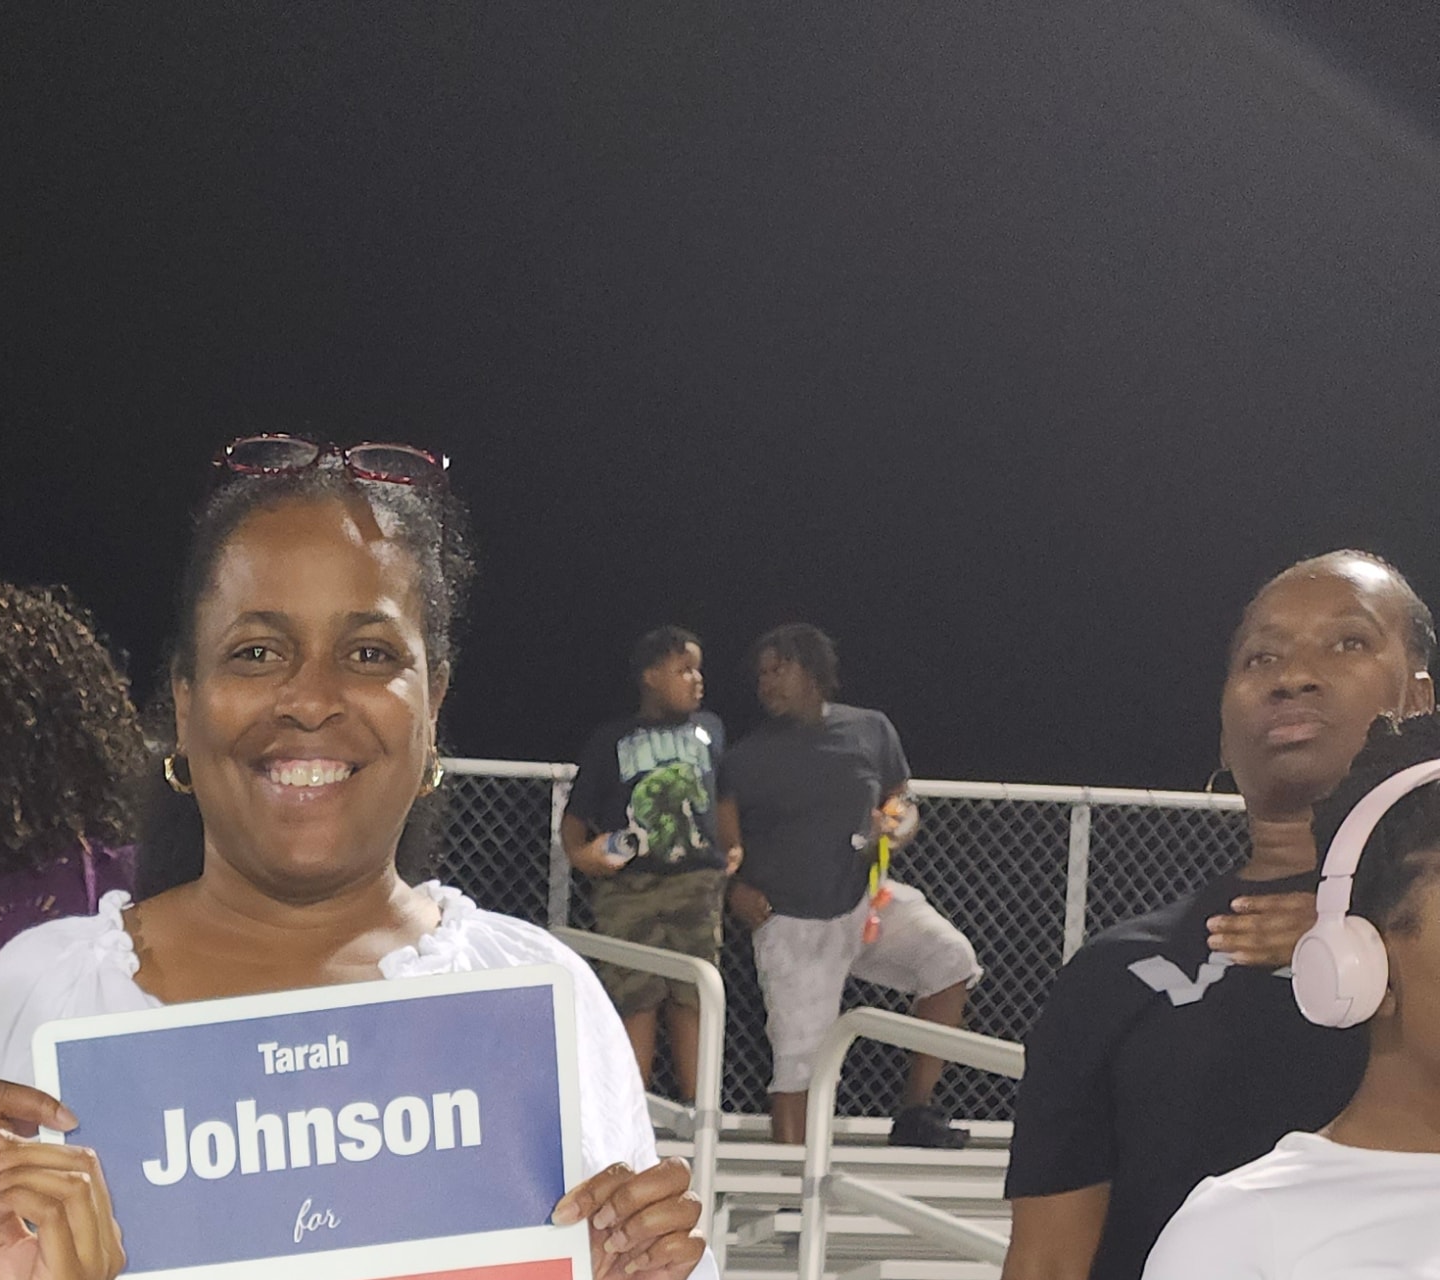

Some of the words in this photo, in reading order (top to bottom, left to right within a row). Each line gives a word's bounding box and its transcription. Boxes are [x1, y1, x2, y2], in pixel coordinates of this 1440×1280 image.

[257, 1033, 350, 1075] Tarah
[141, 1088, 483, 1187] Johnson
[292, 1197, 342, 1244] for
